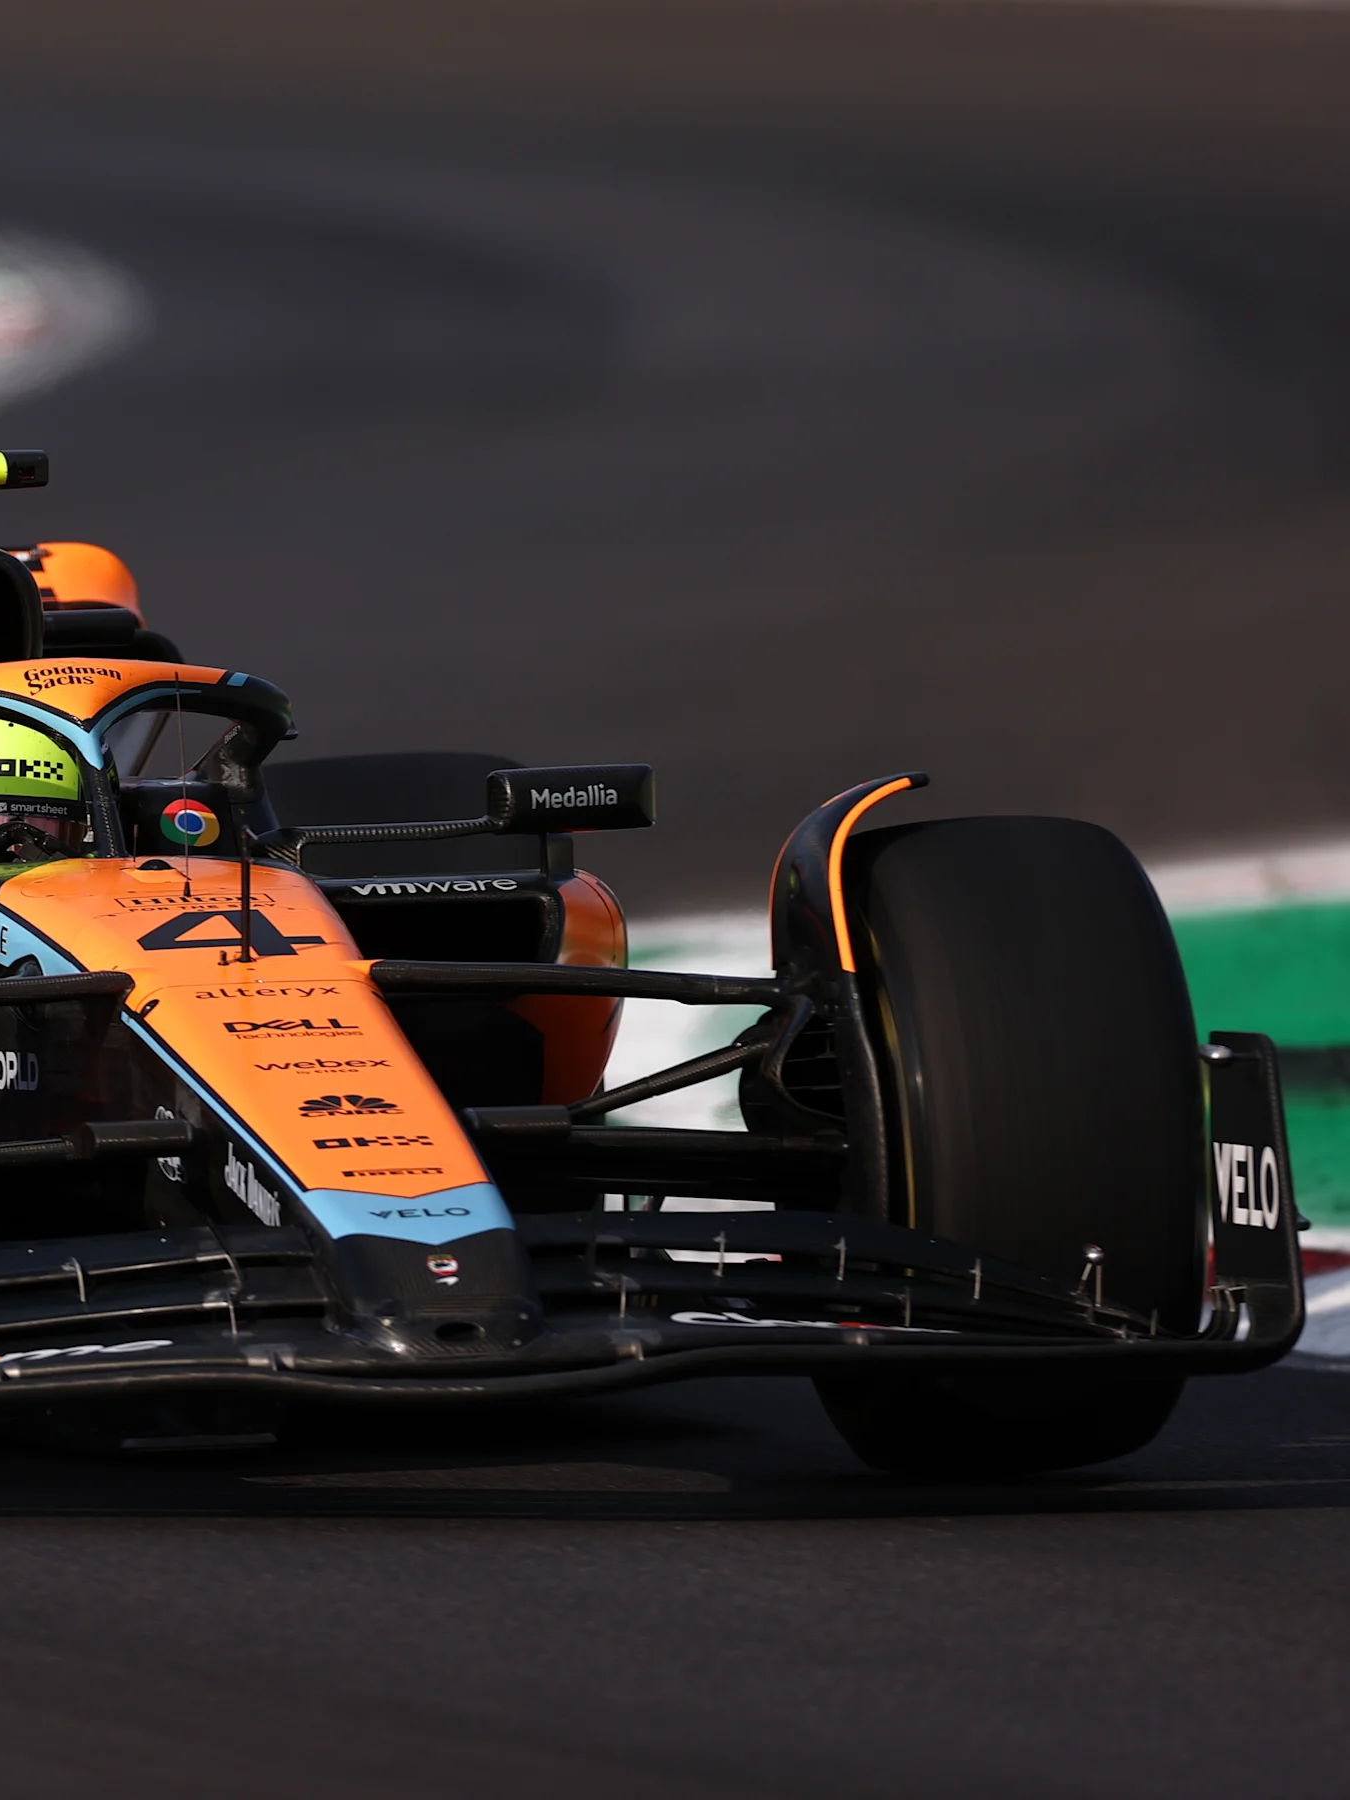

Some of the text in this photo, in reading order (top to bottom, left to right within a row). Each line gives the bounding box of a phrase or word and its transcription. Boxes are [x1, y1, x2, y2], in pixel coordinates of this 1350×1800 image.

[23, 666, 122, 681] Goldman
[27, 675, 95, 696] Sachs
[530, 783, 619, 810] Medallia
[10, 802, 69, 815] smartsheet
[351, 878, 519, 896] vmware
[137, 910, 327, 956] 4
[194, 986, 342, 999] alteryx
[222, 1018, 360, 1032] DELL
[234, 1029, 364, 1040] Technologies
[254, 1057, 393, 1071] webex
[299, 1108, 407, 1118] CNBC
[312, 1135, 434, 1150] OKX
[1212, 1141, 1280, 1230] VELO
[368, 1207, 471, 1219] VELO
